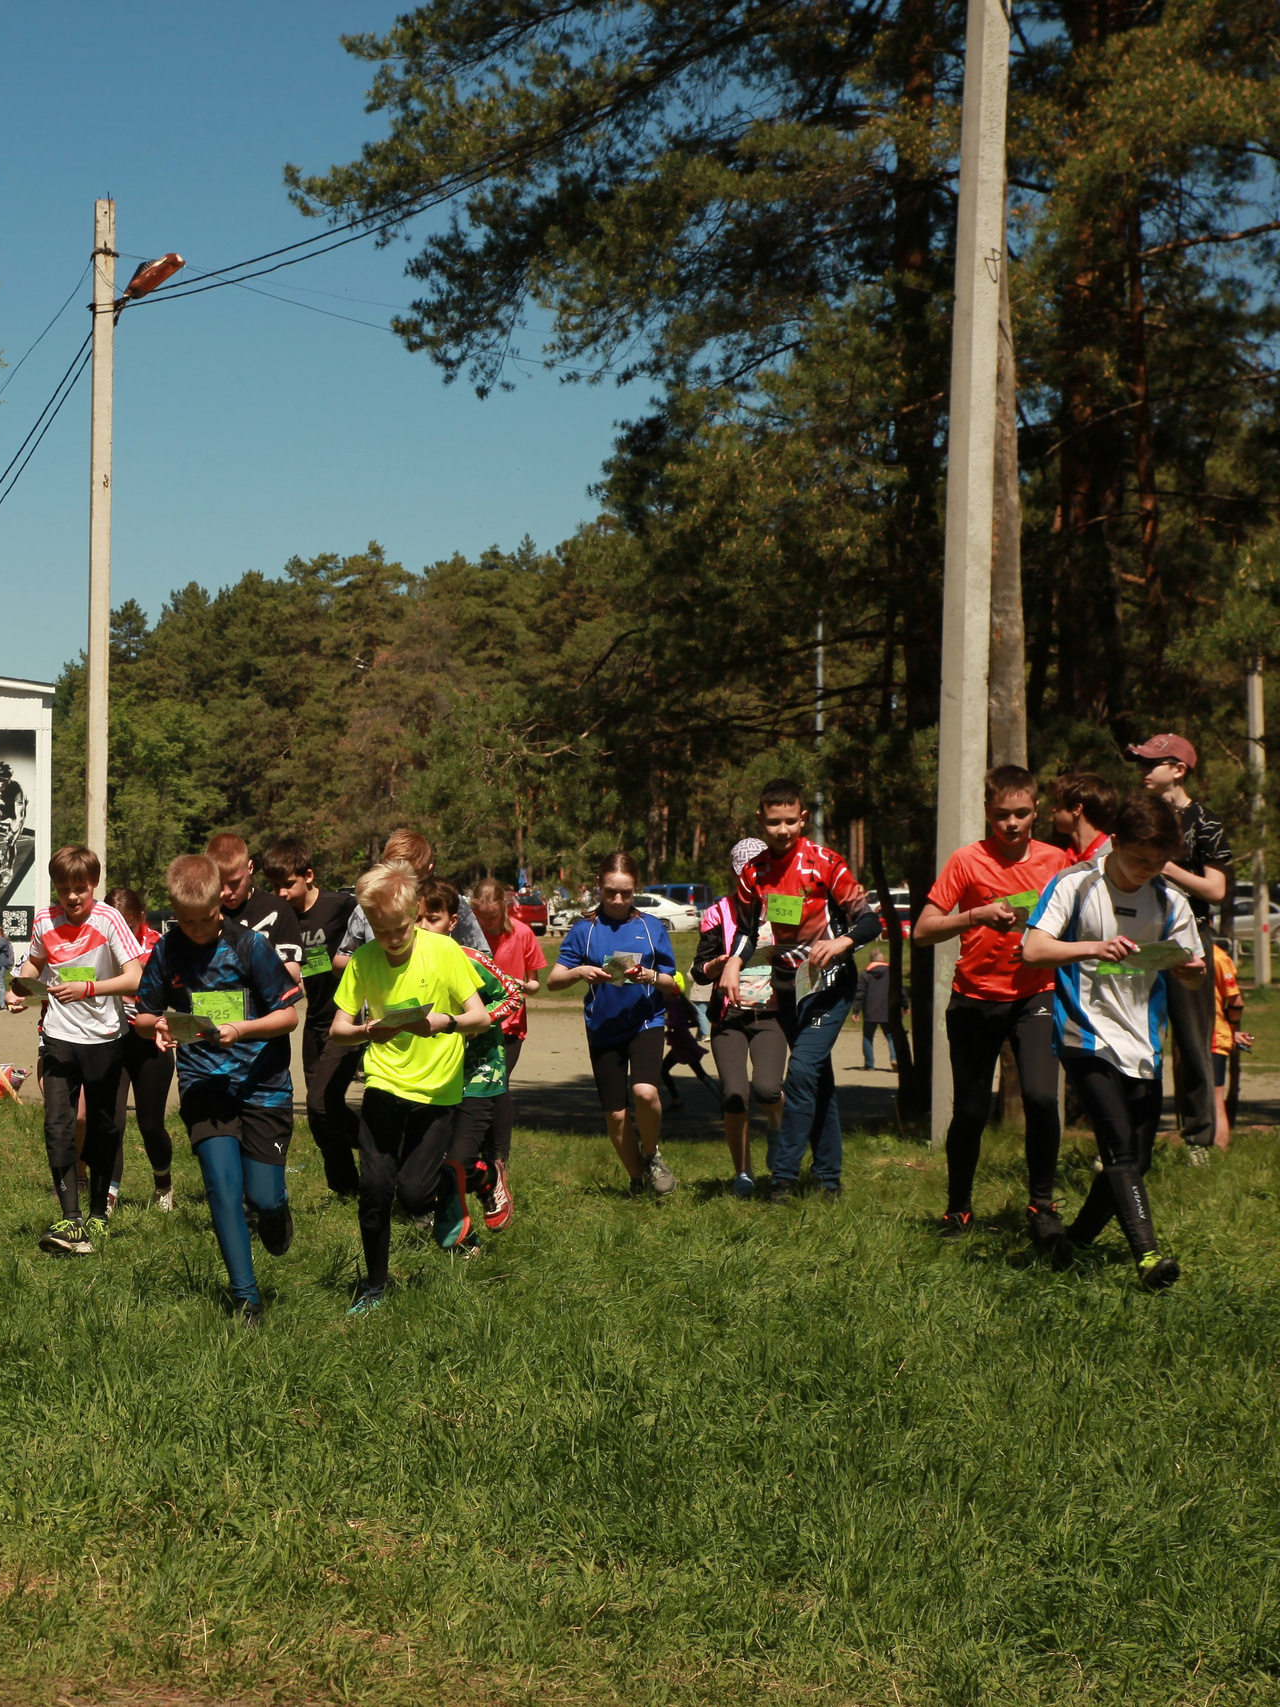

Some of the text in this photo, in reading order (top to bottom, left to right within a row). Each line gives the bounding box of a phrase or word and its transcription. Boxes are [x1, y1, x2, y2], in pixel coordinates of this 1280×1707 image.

[775, 907, 793, 917] 534
[300, 928, 326, 946] ILA
[205, 1009, 230, 1020] 525
